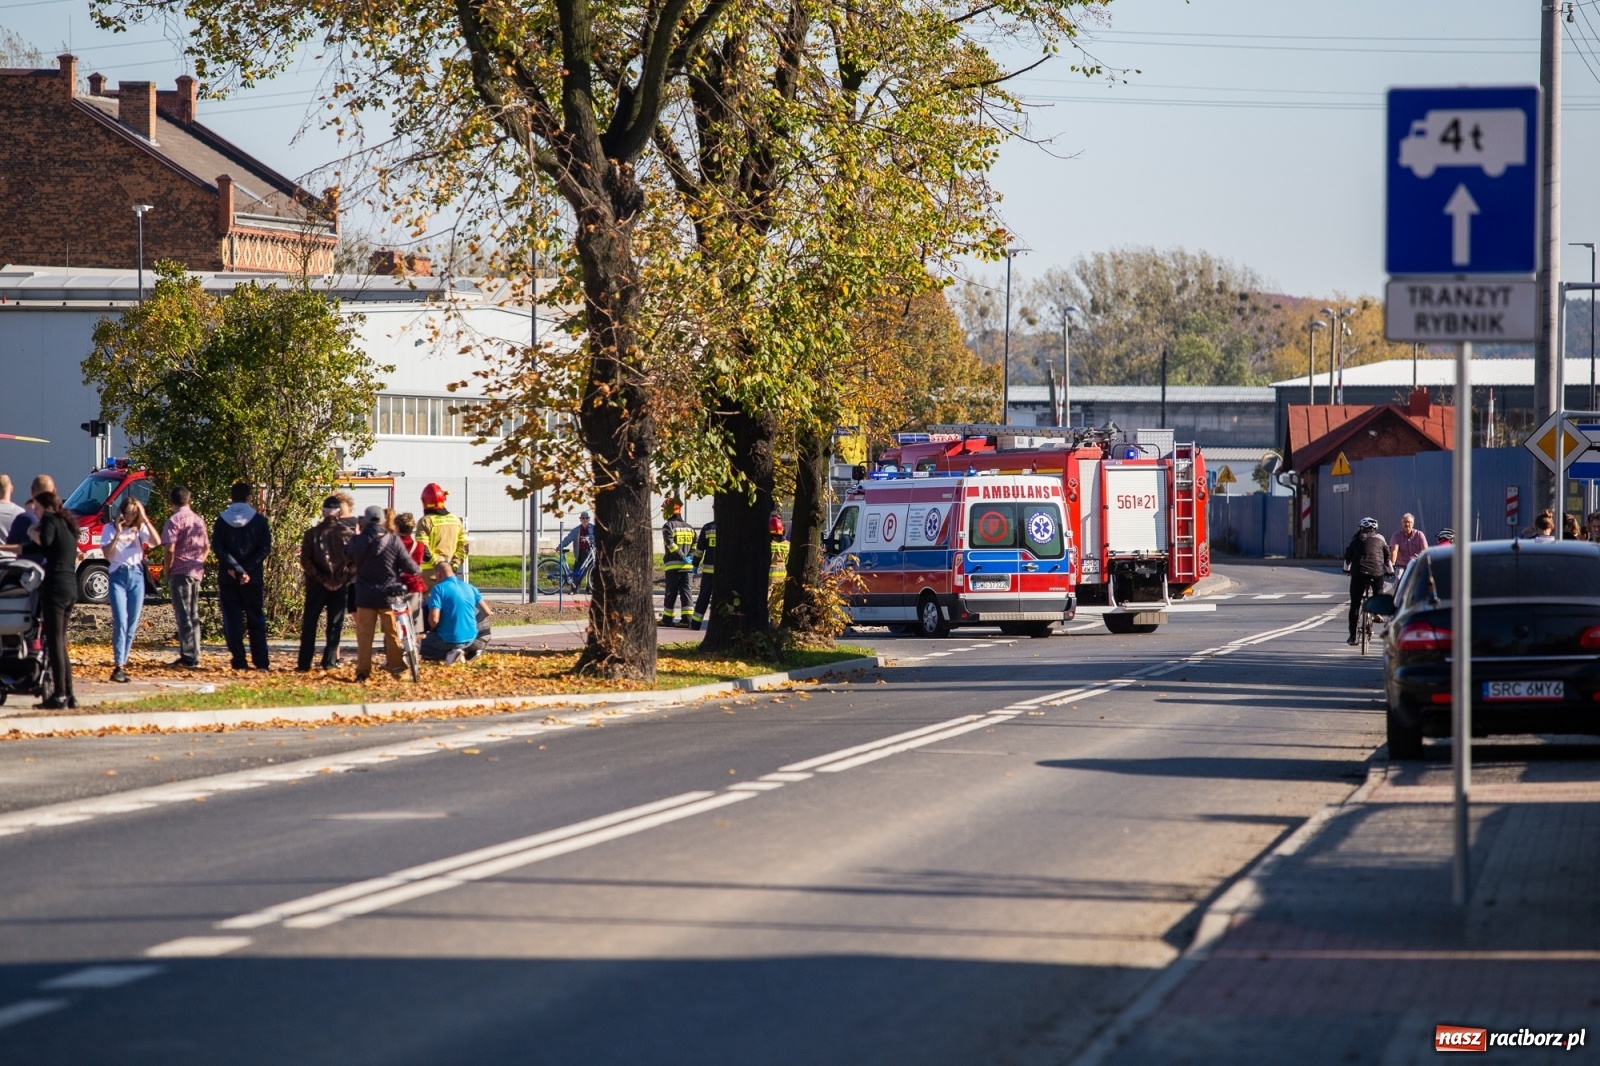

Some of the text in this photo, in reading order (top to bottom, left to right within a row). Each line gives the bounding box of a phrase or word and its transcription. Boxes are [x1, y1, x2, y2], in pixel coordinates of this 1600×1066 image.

[1439, 117, 1483, 152] 4 t
[1406, 286, 1514, 307] TRANZYT
[1414, 312, 1506, 335] RYBNIK
[983, 485, 1051, 499] AMBULANS
[886, 519, 894, 536] P
[988, 518, 1000, 536] P
[1491, 682, 1562, 696] SRC 6MY6
